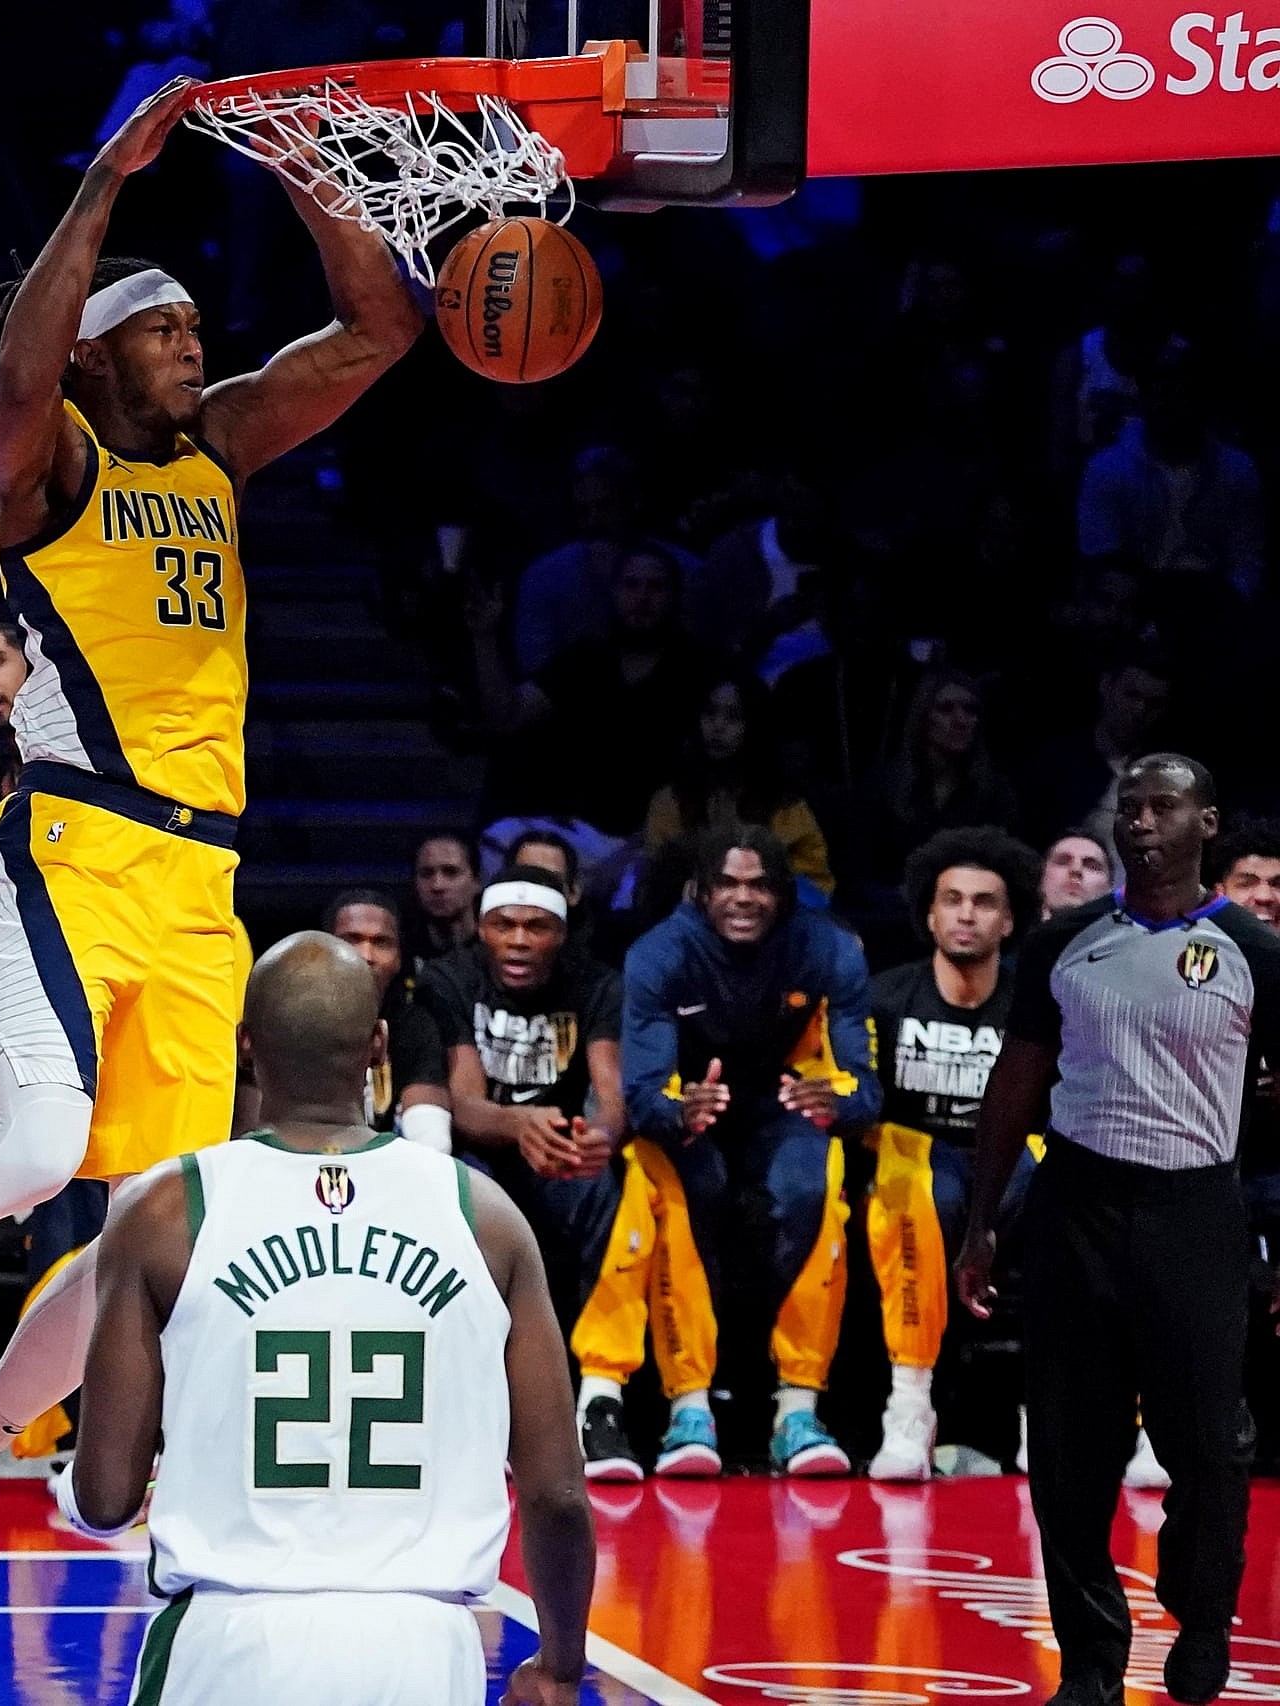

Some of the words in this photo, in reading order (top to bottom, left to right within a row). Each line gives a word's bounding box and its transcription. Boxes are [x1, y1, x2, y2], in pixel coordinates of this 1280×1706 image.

[483, 250, 521, 358] Wilson
[153, 545, 227, 632] 33
[898, 1016, 1003, 1057] NBA
[212, 1222, 468, 1319] MIDDLETON
[253, 1329, 426, 1490] 22
